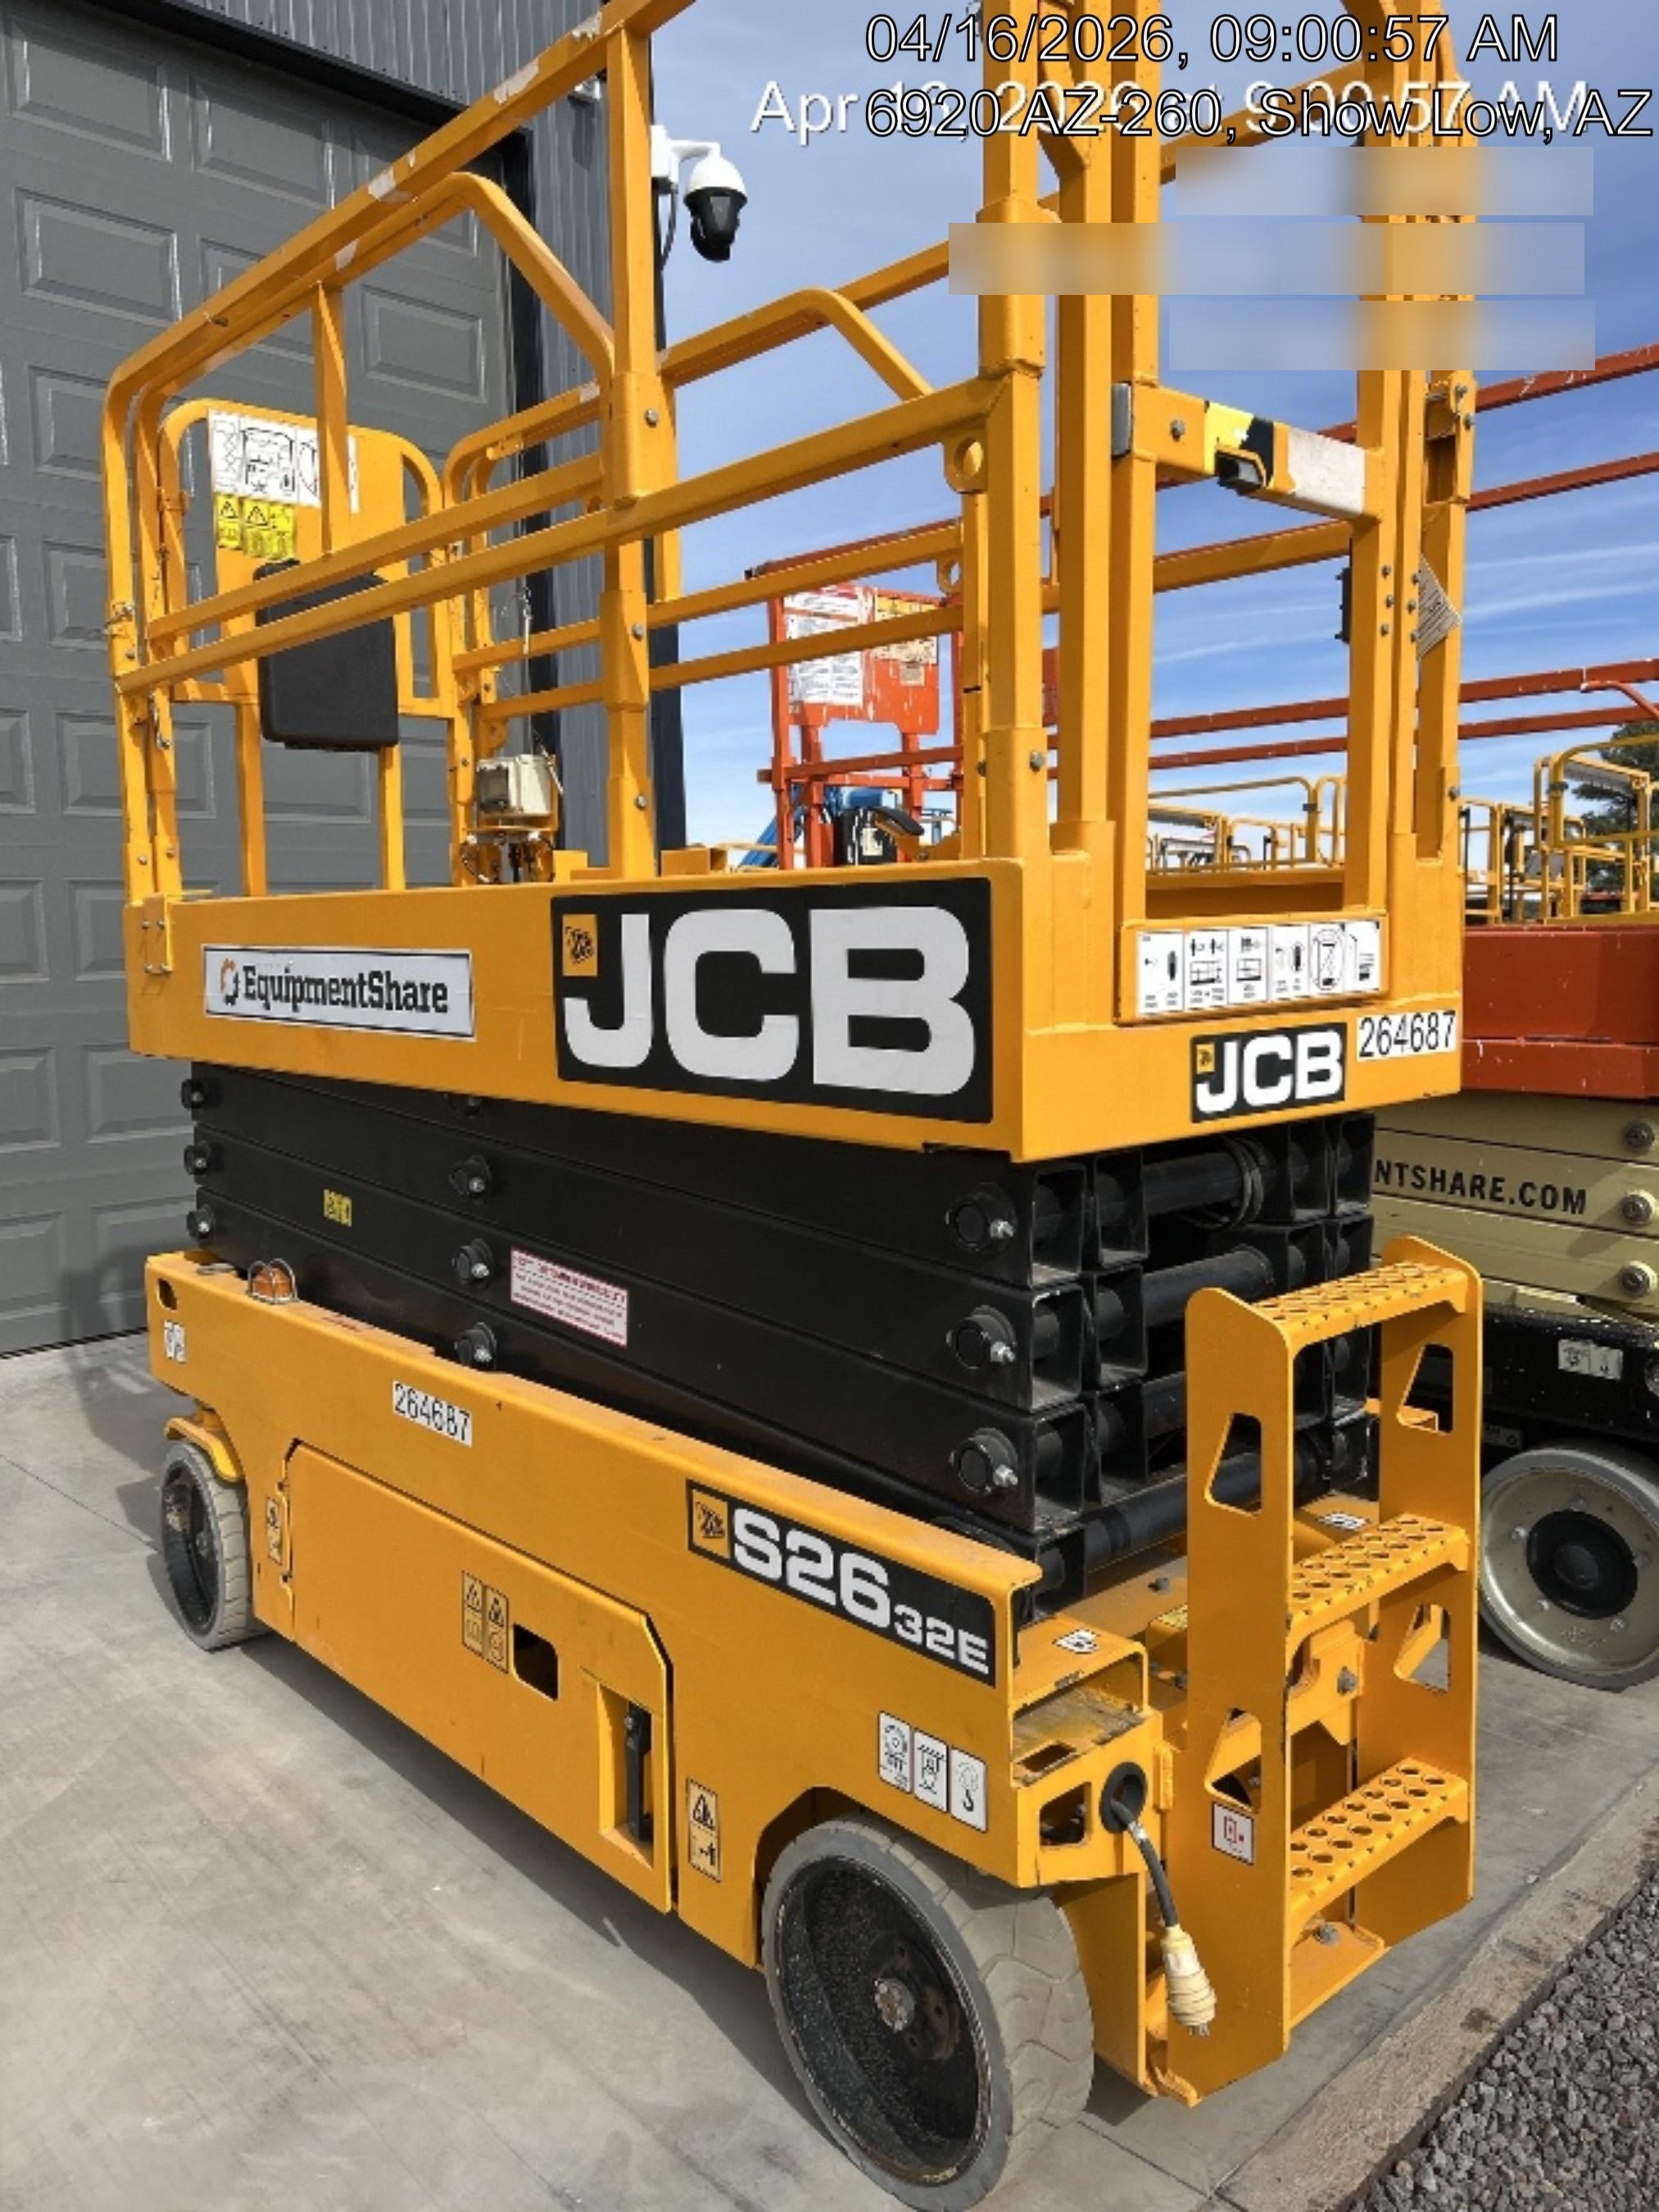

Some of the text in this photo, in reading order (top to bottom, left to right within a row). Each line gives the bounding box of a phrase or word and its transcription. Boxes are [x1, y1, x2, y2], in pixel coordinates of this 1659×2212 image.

[243, 964, 448, 1013] EquipmentShare
[563, 906, 975, 1095] JCB
[1358, 1010, 1456, 1058] 264687
[1196, 1031, 1344, 1113] JCB
[395, 1382, 470, 1441] 264687
